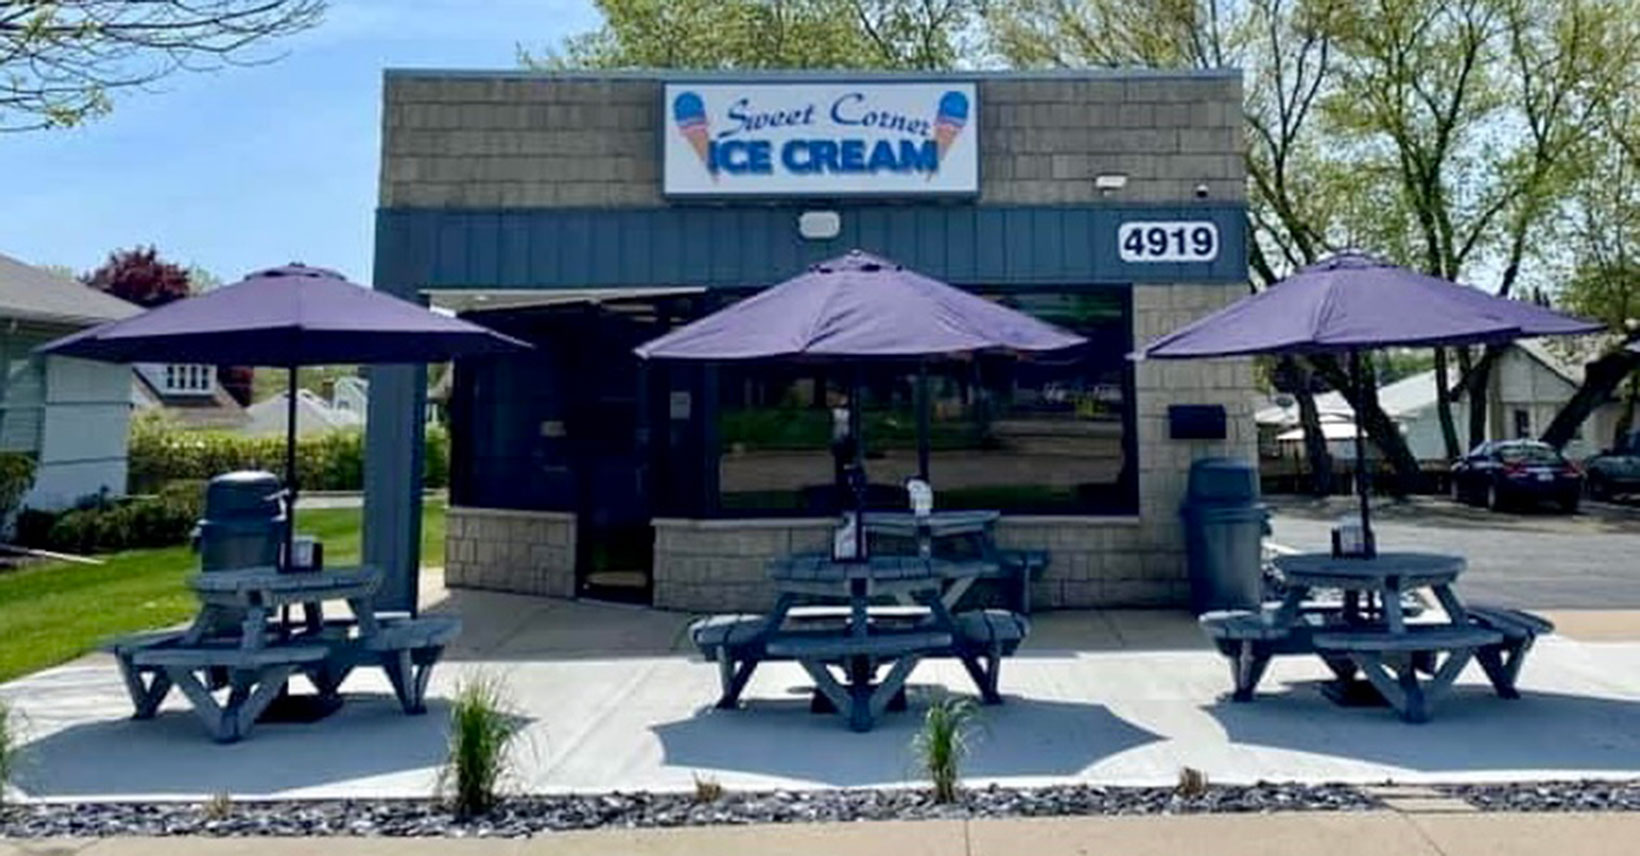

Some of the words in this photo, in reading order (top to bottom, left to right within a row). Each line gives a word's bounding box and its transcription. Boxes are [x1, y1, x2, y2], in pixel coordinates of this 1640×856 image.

[718, 99, 815, 138] Sweet
[830, 92, 932, 137] Corner
[708, 139, 773, 174] ICE
[781, 139, 939, 175] CREAM
[1124, 227, 1213, 256] 4919
